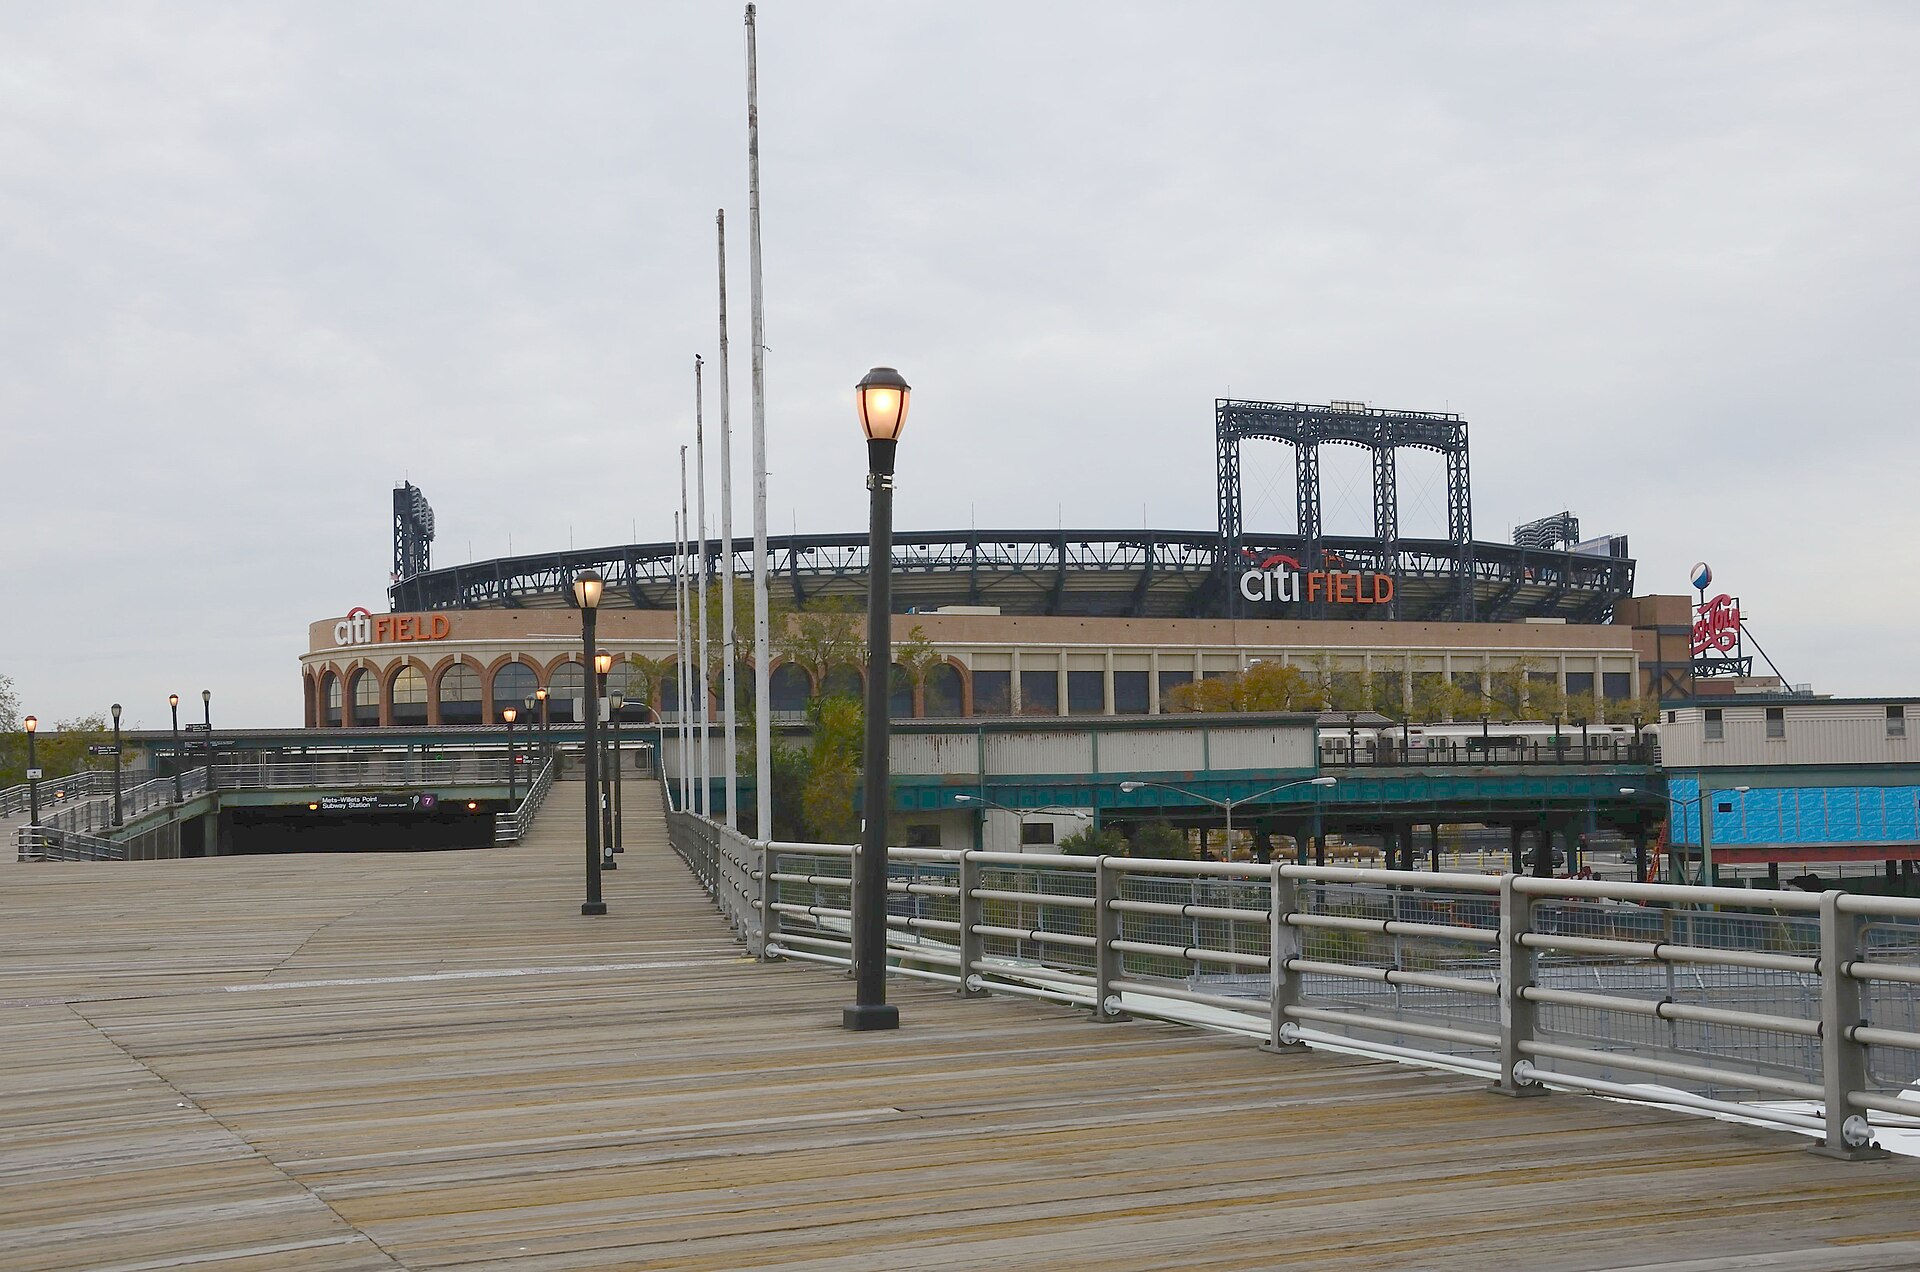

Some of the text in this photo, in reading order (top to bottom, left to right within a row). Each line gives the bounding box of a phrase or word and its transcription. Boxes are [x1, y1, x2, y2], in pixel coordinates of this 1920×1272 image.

[1239, 555, 1394, 603] citi FIELD
[334, 607, 450, 645] citi FIELD
[425, 797, 431, 805] 7
